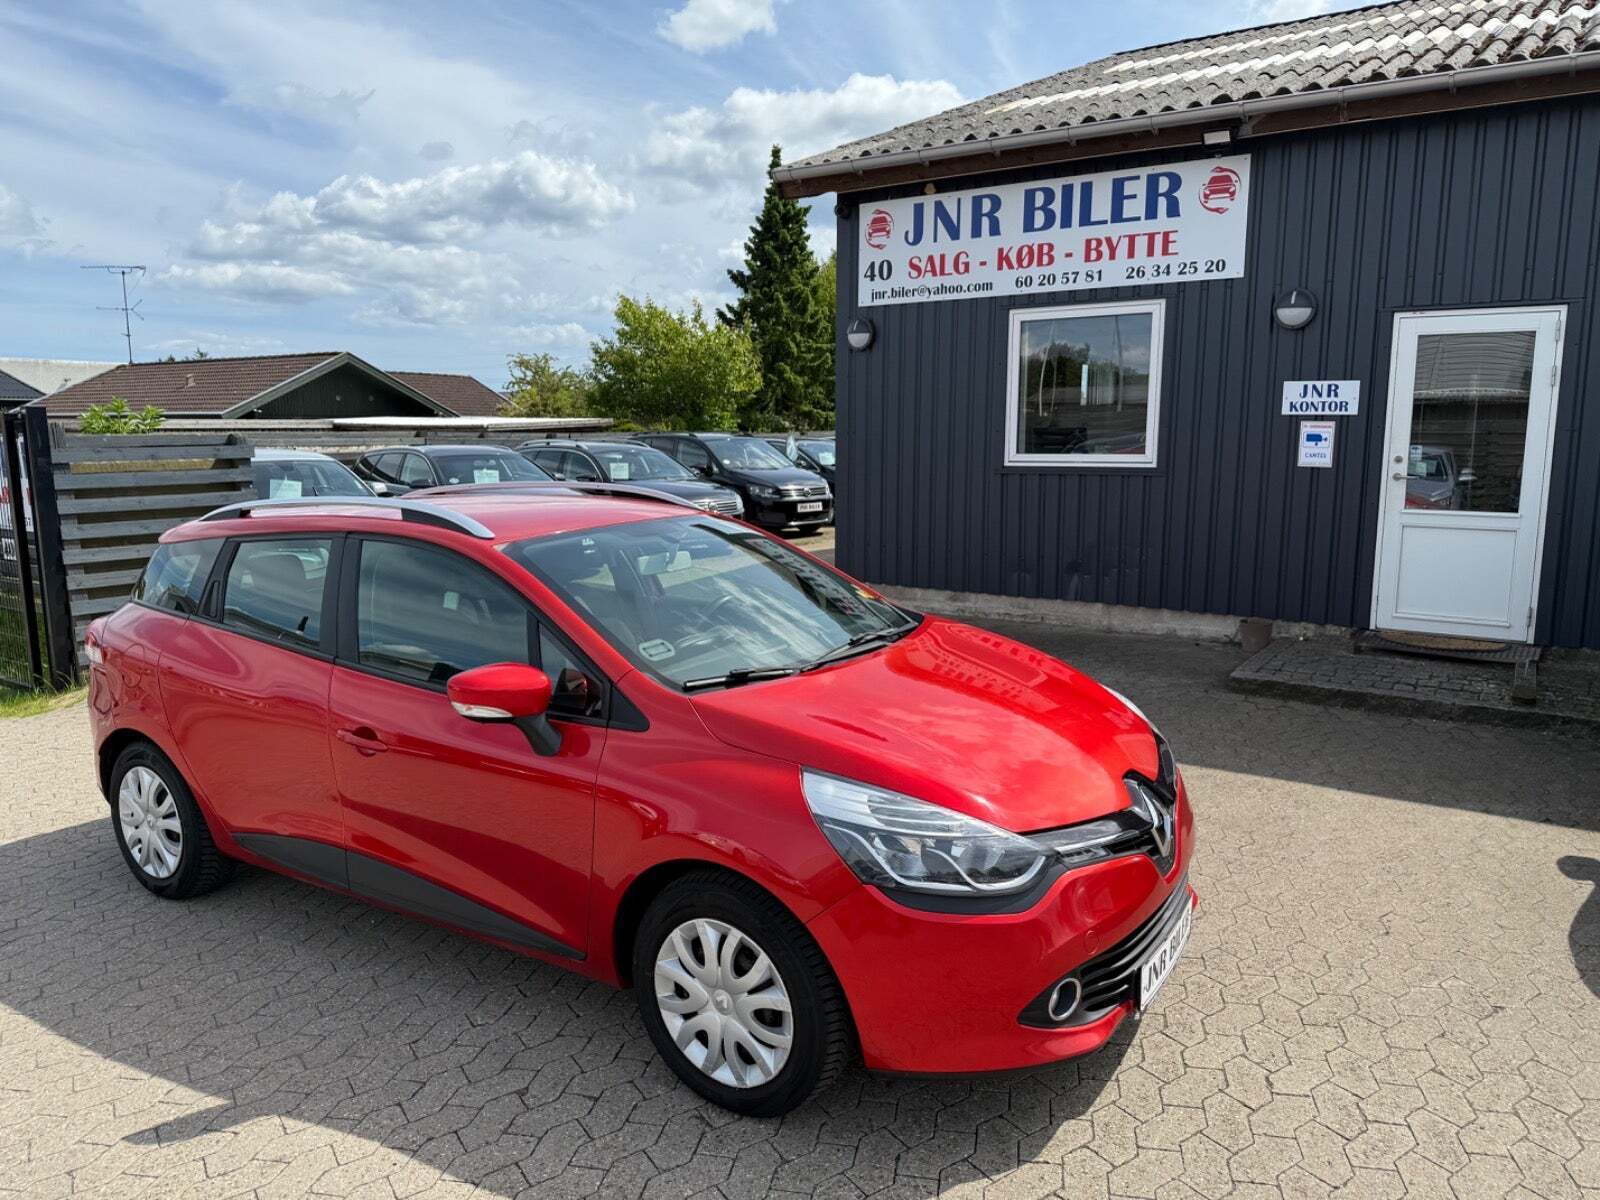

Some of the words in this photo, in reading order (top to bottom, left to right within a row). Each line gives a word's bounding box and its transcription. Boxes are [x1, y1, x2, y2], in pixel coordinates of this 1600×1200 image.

[904, 193, 1002, 247] JNR
[1022, 171, 1183, 233] BILER
[908, 251, 970, 279] SALG
[997, 242, 1055, 272] KØB
[1084, 230, 1179, 263] BYTTE
[864, 259, 893, 282] 40
[1015, 275, 1033, 288] 60
[1038, 273, 1056, 287] 20
[1061, 271, 1079, 285] 57
[1085, 269, 1102, 283] 81
[1126, 265, 1146, 279] 26
[1152, 263, 1171, 277] 34
[1178, 261, 1198, 275] 25
[1204, 259, 1226, 273] 20
[871, 281, 993, 302] jnr.biler@yahoo.com
[1299, 383, 1339, 398] JNR
[1289, 401, 1349, 412] KONTOR
[1143, 949, 1167, 992] JNR
